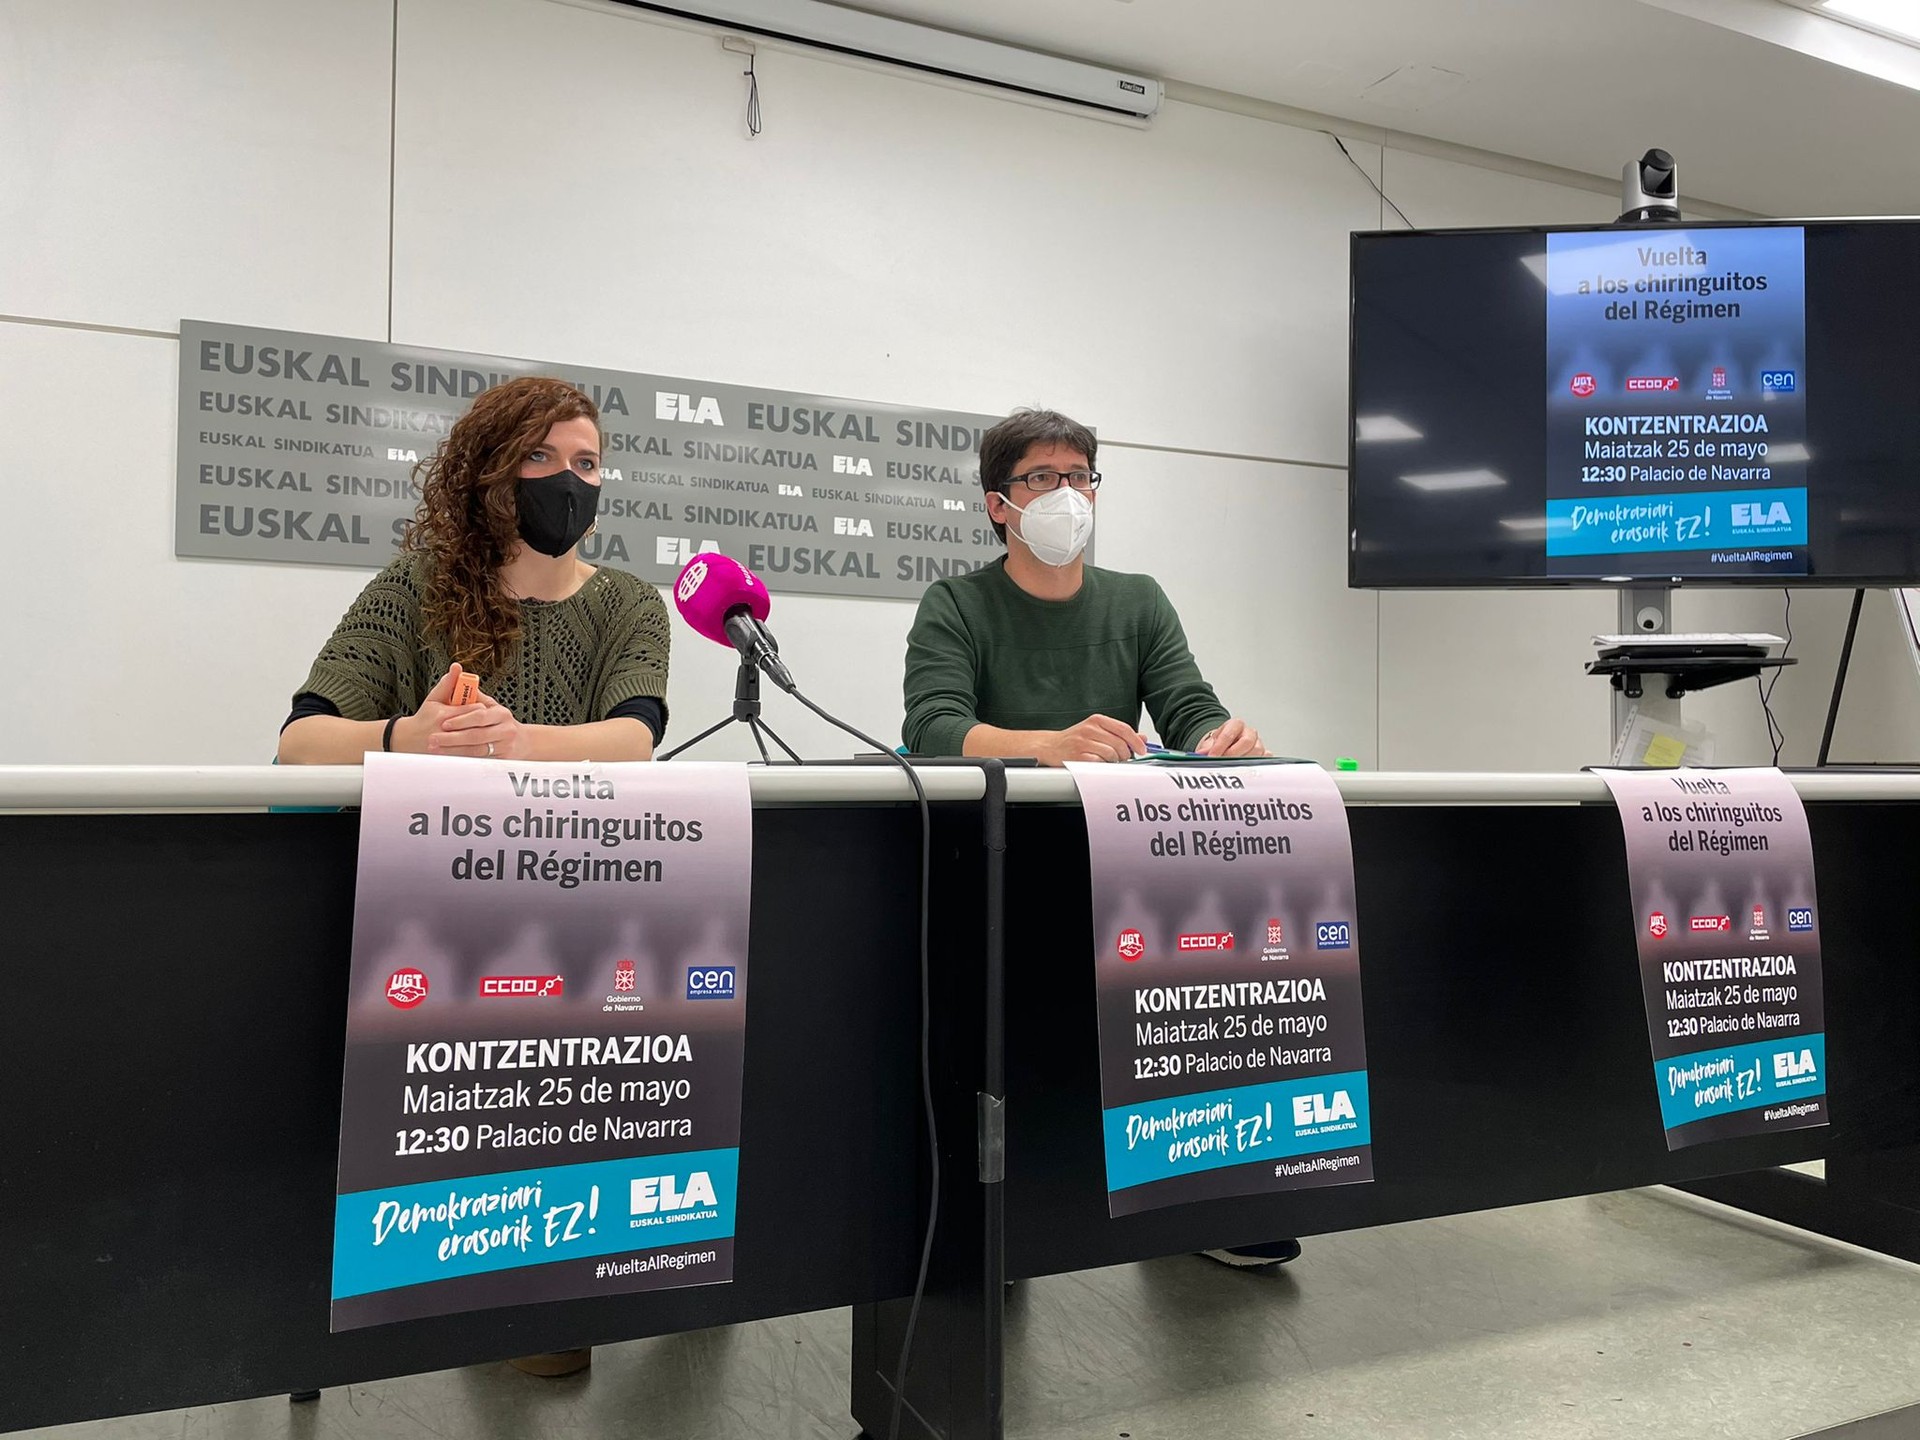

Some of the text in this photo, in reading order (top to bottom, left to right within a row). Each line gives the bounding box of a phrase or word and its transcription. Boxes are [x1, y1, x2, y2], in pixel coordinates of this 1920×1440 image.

[1638, 247, 1707, 266] Vuelta
[1578, 272, 1768, 296] a los chiringuitos
[1605, 300, 1740, 323] del Régimen
[1763, 372, 1794, 386] cen
[200, 340, 370, 388] EUSKAL
[655, 391, 724, 427] ELA
[748, 403, 880, 443] EUSKAL
[896, 420, 982, 453] SINDI
[1585, 414, 1769, 436] KONTZENTRAZIOA
[200, 391, 312, 422] EUSKAL
[601, 431, 672, 456] USKAL
[684, 440, 818, 470] SINDIKATUA
[833, 455, 873, 477] ELA
[886, 461, 962, 486] EUSKAL
[1584, 439, 1768, 462] Maiatzak 25 de mayo
[200, 431, 266, 449] EUSKAL
[274, 438, 375, 459] SINDIKATUA
[387, 448, 418, 463] ELA
[631, 471, 684, 487] EUSKAL
[690, 476, 769, 494] SINDIKATUA
[778, 484, 803, 497] ELA
[812, 487, 859, 503] EUSKAL
[864, 492, 936, 509] SINDIKATUA
[943, 499, 966, 512] ELA
[1582, 464, 1771, 482] 12:30 Palacio de Navarra
[200, 464, 312, 493] EUSKAL
[597, 497, 673, 521] USKAL
[684, 504, 818, 533] SINDIKATUA
[834, 516, 874, 538] ELA
[887, 521, 963, 545] EUSKAL
[1571, 501, 1673, 531] Demokraziari
[1731, 501, 1791, 527] ELA
[200, 504, 370, 545] EUSKAL
[748, 544, 880, 579] EUSKAL
[1610, 523, 1670, 543] erasorik
[1711, 551, 1792, 563] #VueltaAlRegimen
[508, 771, 615, 800] Vuelta
[1166, 771, 1244, 790] Vuelta
[1671, 778, 1731, 795] Vuelta
[1116, 798, 1313, 827] a los chiringuitos
[1641, 802, 1783, 826] a los chiringuitos
[409, 806, 703, 848] a los chiringuitos
[1150, 830, 1291, 861] del Régimen
[1669, 830, 1769, 856] del Régimen
[451, 849, 663, 889] del Régimen
[1789, 909, 1812, 925] cen
[1120, 933, 1141, 946] UGT
[1180, 936, 1216, 948] CCOO
[1317, 923, 1349, 942] cen
[392, 973, 422, 989] UGT
[689, 968, 733, 990] cen
[1663, 955, 1796, 983] KONTZENTRAZIOA
[484, 979, 537, 993] CCOO
[1135, 978, 1327, 1013] KONTZENTRAZIOA
[1666, 985, 1797, 1010] Maiatzak 25 de mayo
[602, 1003, 644, 1012] de Navarra
[606, 995, 641, 1004] Gobierno
[1136, 1013, 1327, 1046] Maiatzak 25 de mayo
[1667, 1012, 1800, 1037] 12:30 Palacio de Navarra
[406, 1034, 693, 1073] KONTZENTRAZIOA
[1134, 1045, 1331, 1079] 12:30 Palacio de Navarra
[1773, 1049, 1816, 1079] ELA
[1668, 1055, 1735, 1096] Demokraziari
[403, 1076, 691, 1115] Maiatzak 25 de mayo
[1694, 1077, 1734, 1107] erasorik
[1292, 1090, 1356, 1126] ELA
[1764, 1102, 1820, 1121] #VueltaAlRegimen
[395, 1116, 692, 1156] 12:30 Palacio de Navarra
[1126, 1098, 1233, 1150] Demokraziari
[1168, 1101, 1273, 1163] erasorik EZ!
[1295, 1122, 1357, 1137] EUSKAL SINDIKATUA
[1275, 1155, 1360, 1177] #VueltaAlRegimen
[630, 1171, 718, 1216] ELA
[371, 1180, 543, 1246] Demokraziari
[438, 1184, 599, 1262] erasorik EZ!
[630, 1210, 718, 1229] EUSKAL SINDIKATUA
[595, 1249, 716, 1279] #VueltaAlRegimen
